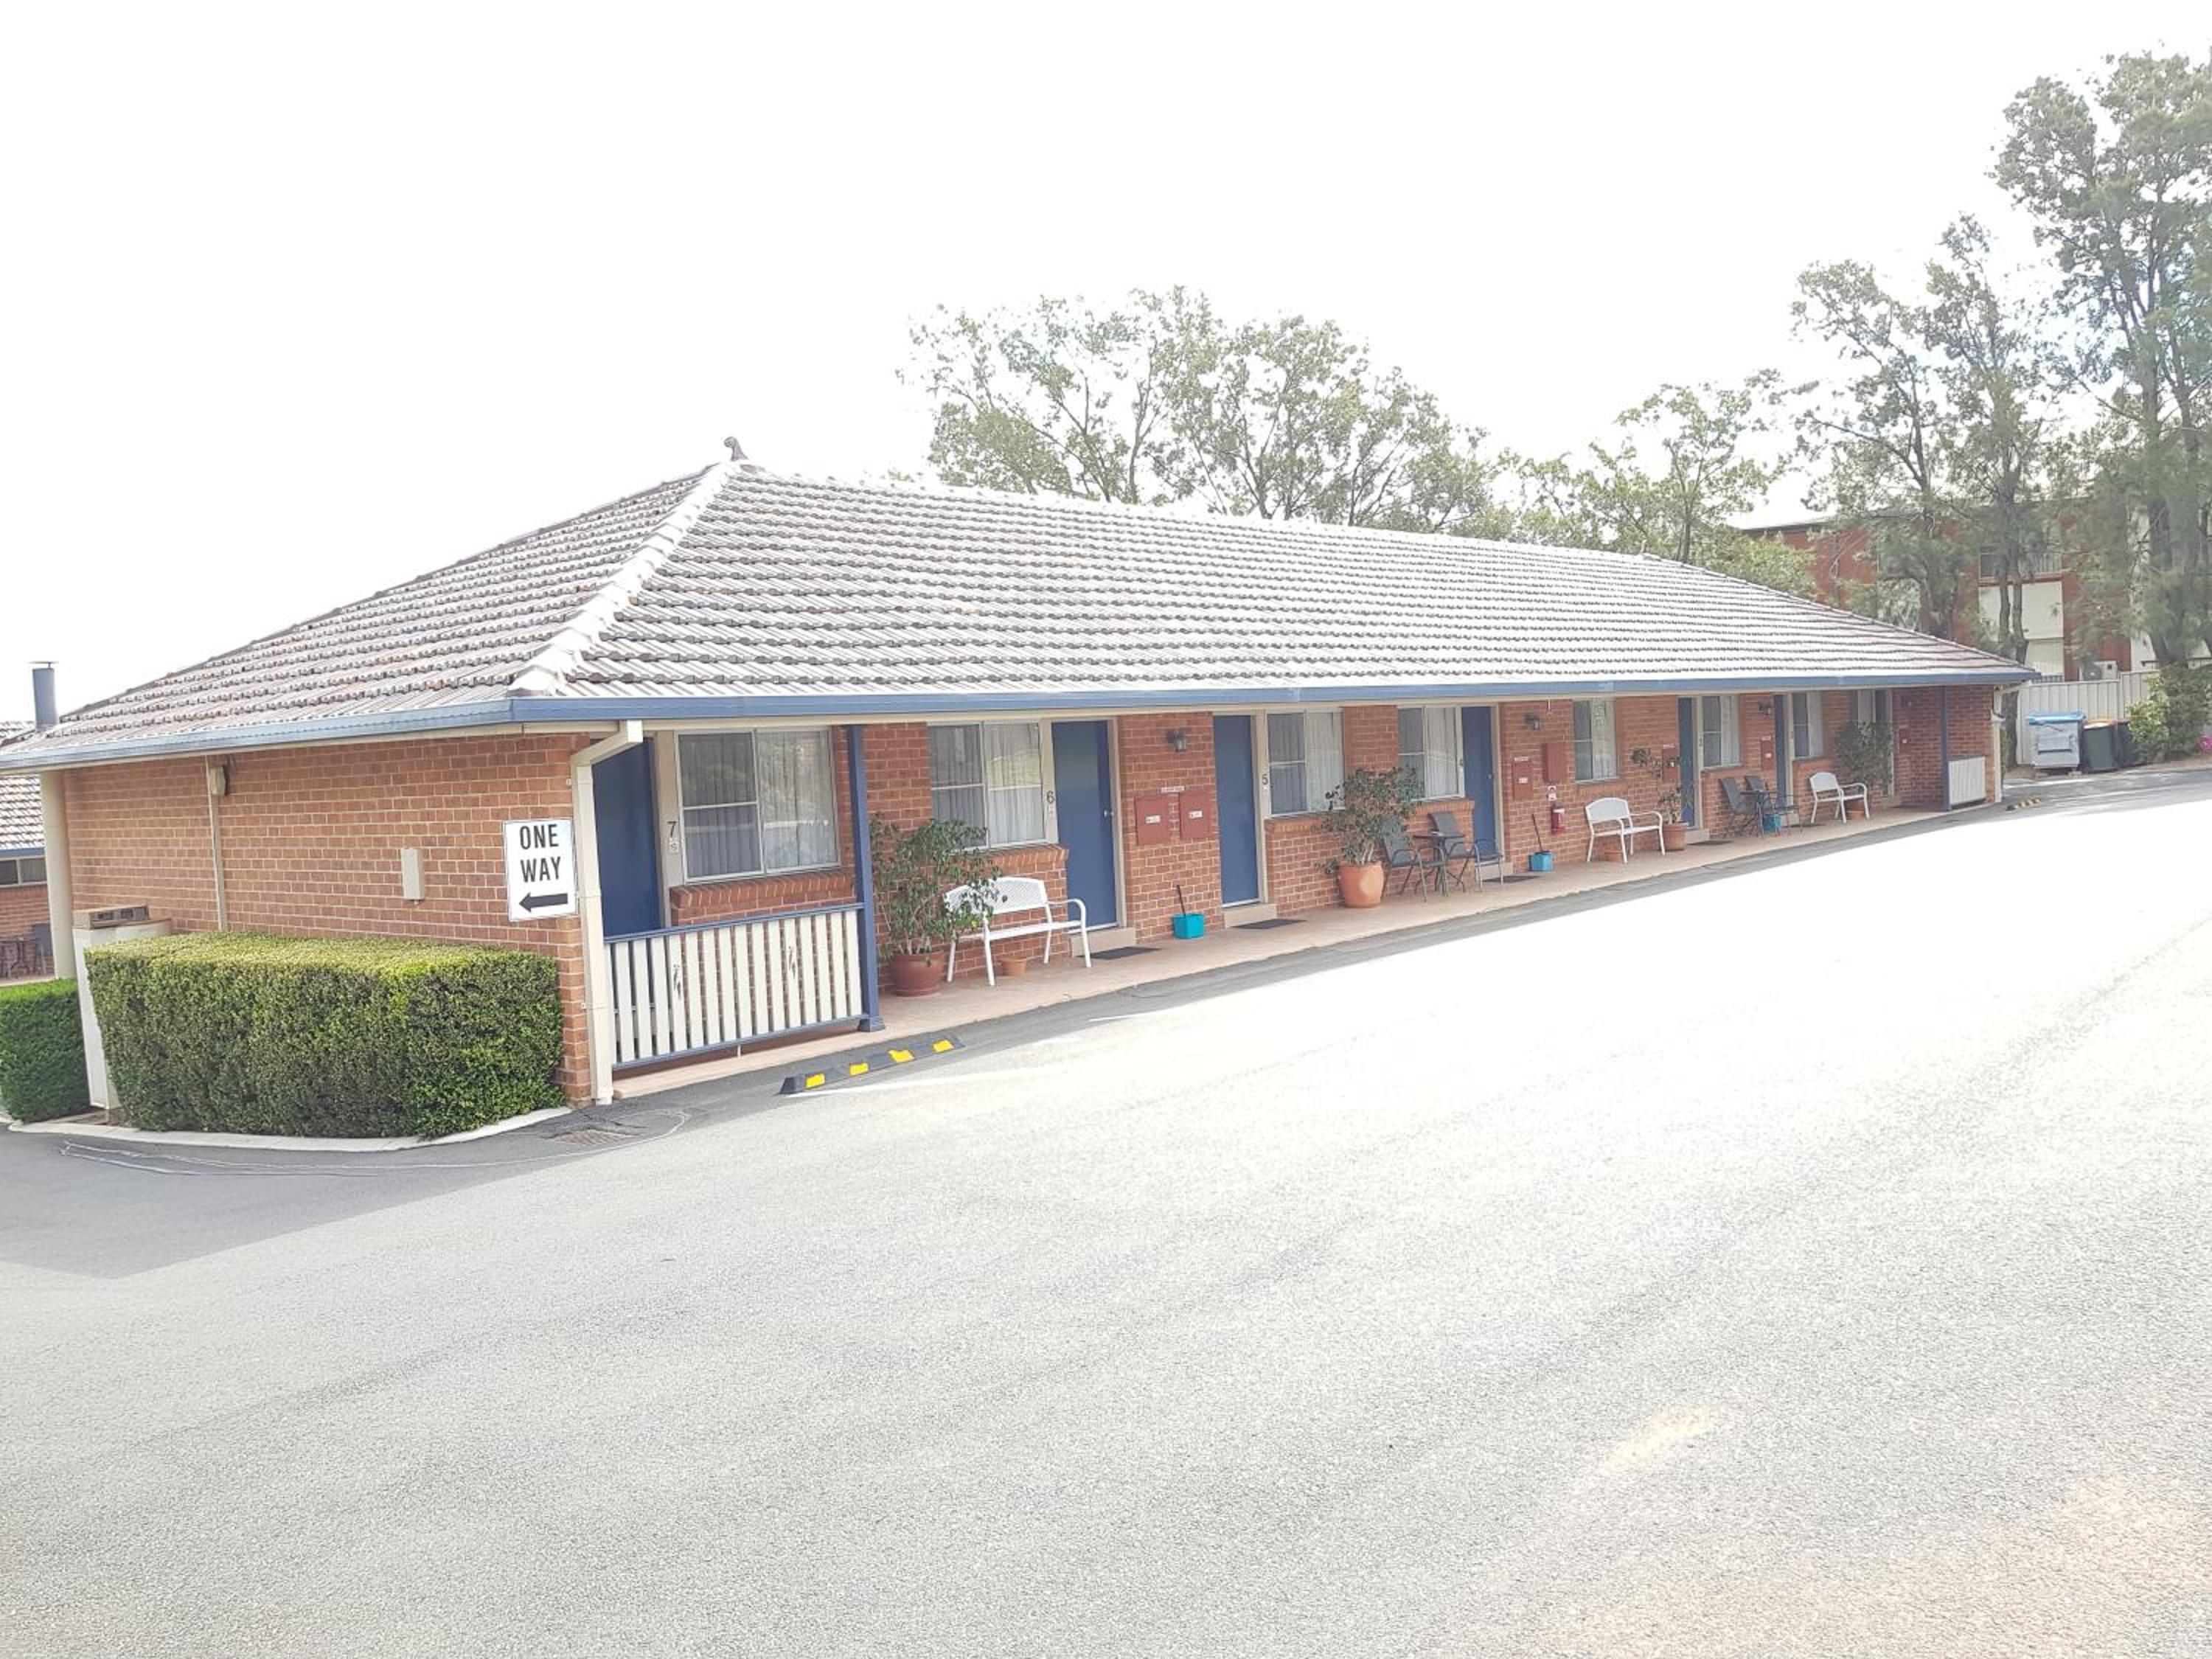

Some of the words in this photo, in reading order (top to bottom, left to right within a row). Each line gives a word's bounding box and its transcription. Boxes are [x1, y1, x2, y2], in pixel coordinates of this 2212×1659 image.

[1262, 773, 1269, 785] 5
[1047, 790, 1055, 804] 6
[520, 824, 559, 850] ONE
[666, 821, 678, 838] 7
[521, 856, 561, 883] WAY
